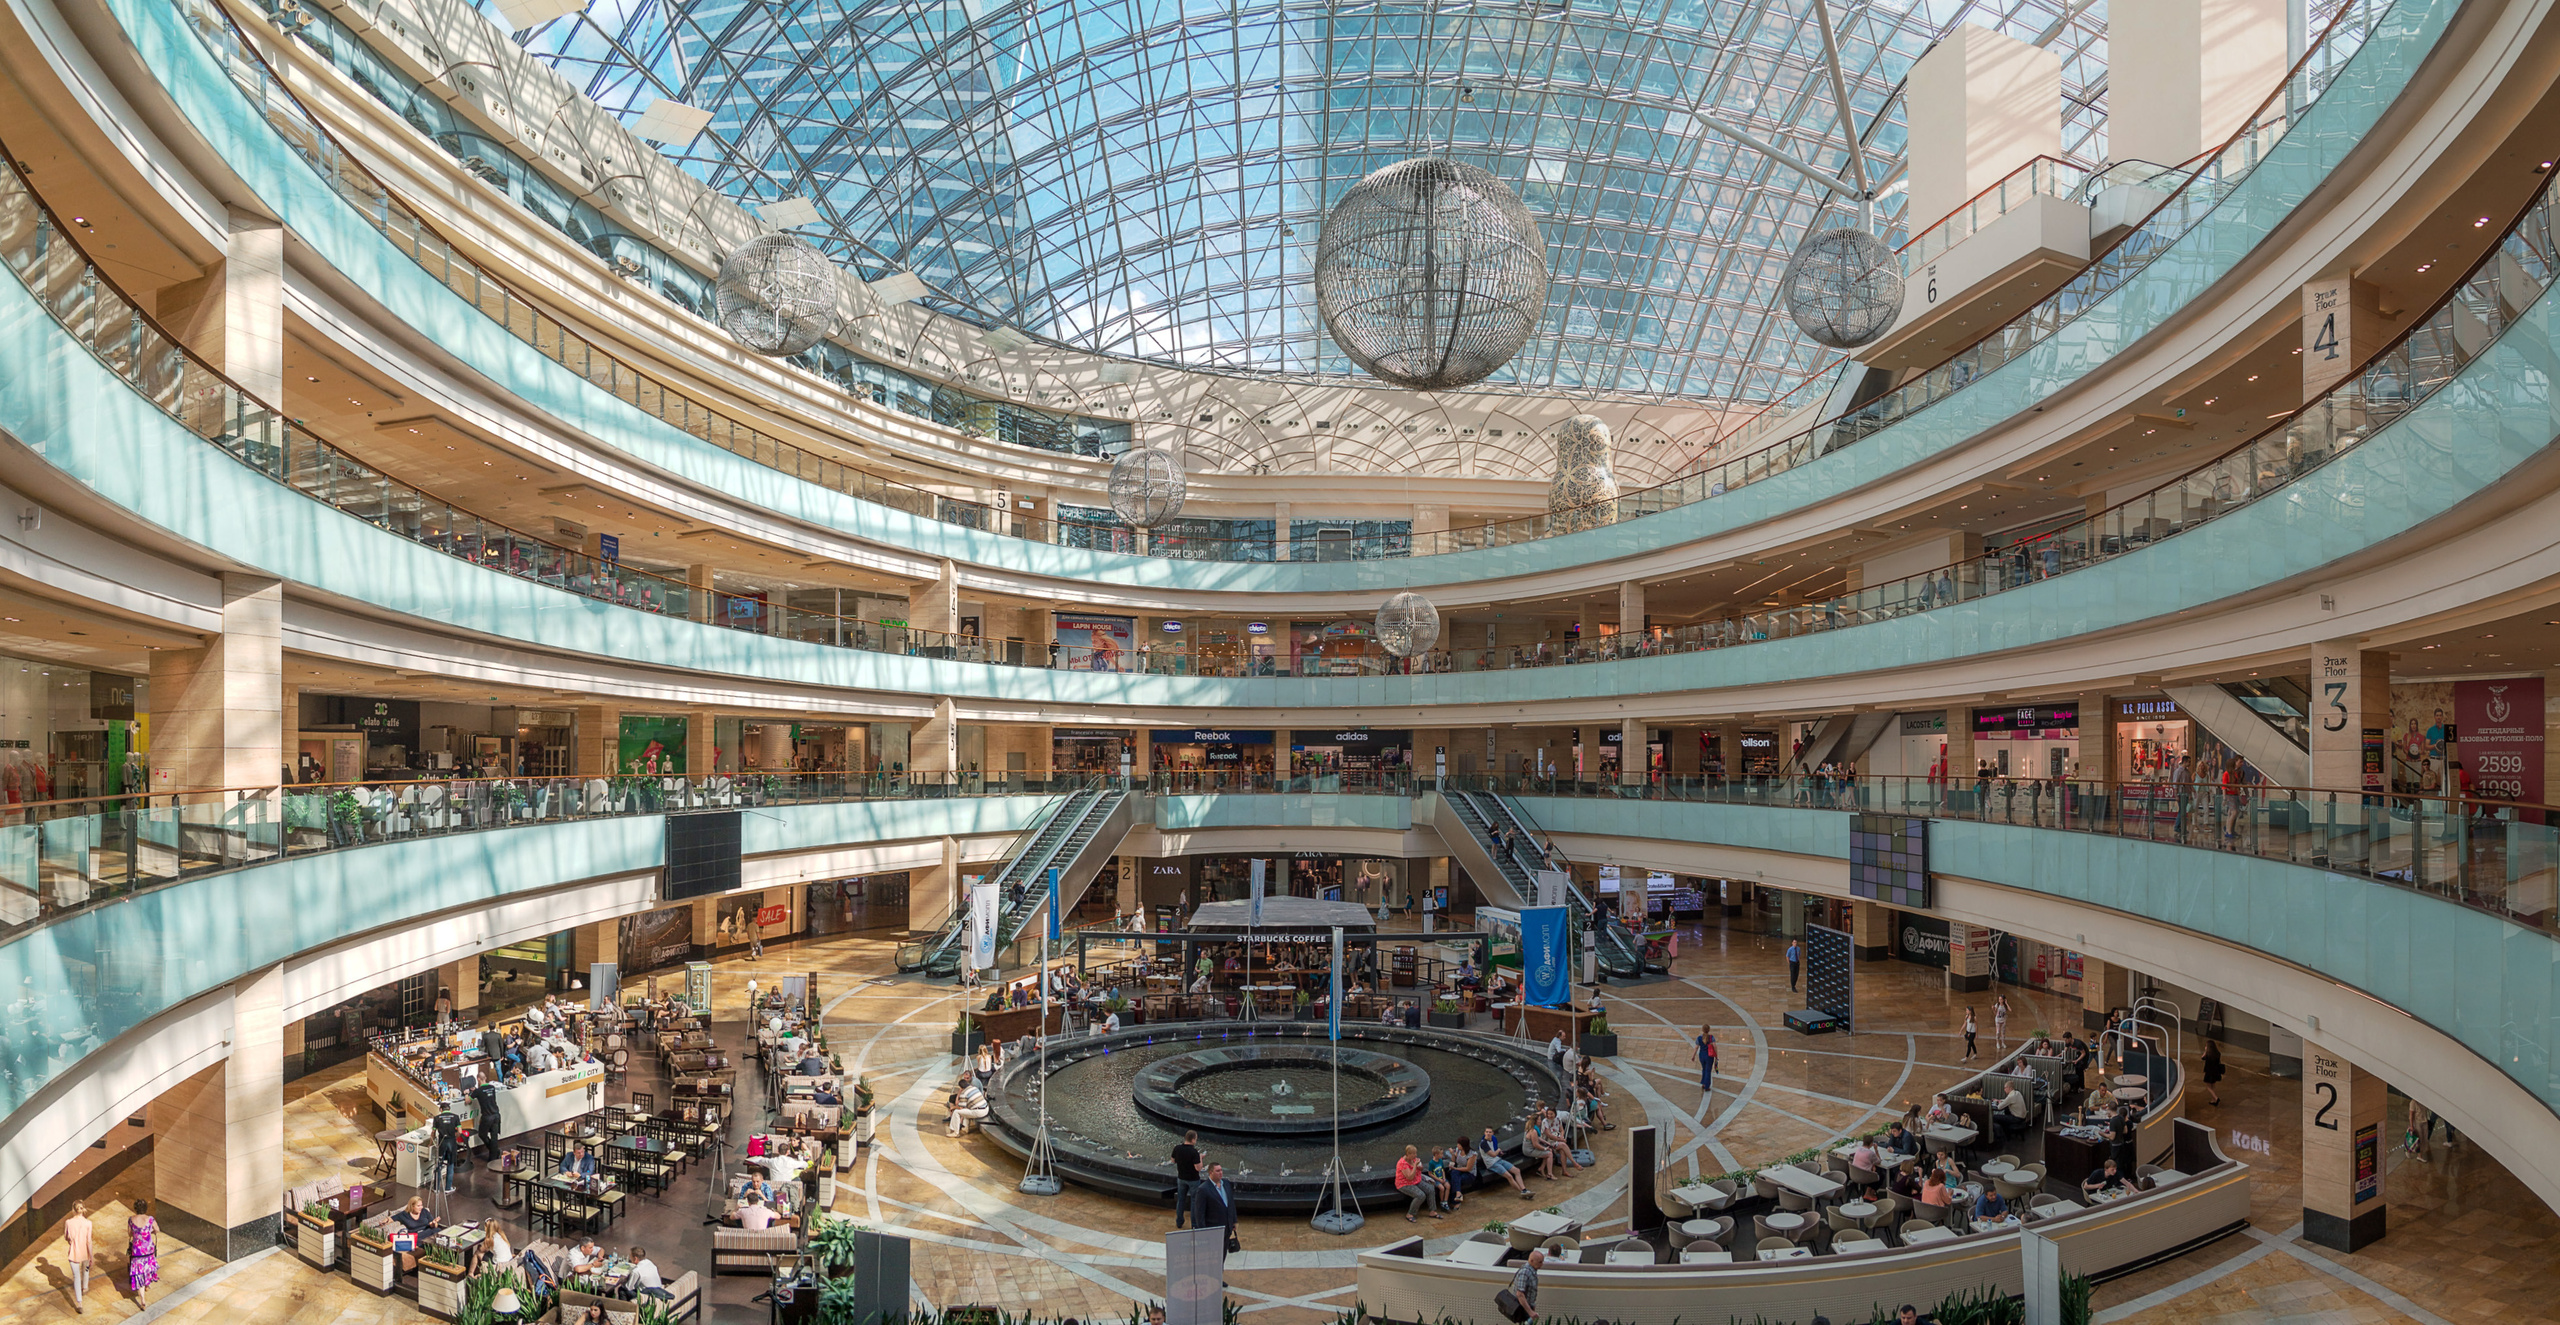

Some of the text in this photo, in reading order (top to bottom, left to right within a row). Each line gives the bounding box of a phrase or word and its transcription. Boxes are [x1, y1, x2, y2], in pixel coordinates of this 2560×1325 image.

[1928, 278, 1937, 303] 6
[2314, 288, 2338, 302] Этаж
[2315, 299, 2337, 312] Floor
[2313, 312, 2340, 361] 4
[997, 492, 1006, 509] 5
[1150, 547, 1207, 560] СОБЕРИ СВОЙ!
[1092, 623, 1112, 631] HOUSE
[1488, 631, 1494, 641] 4
[2323, 656, 2348, 666] Этаж
[2324, 666, 2347, 677] Floor
[2122, 703, 2135, 714] U.S.
[2137, 702, 2154, 714] POLO
[2323, 682, 2348, 732] 3
[2017, 710, 2033, 719] FACE
[1906, 720, 1931, 729] LACOSTE
[1194, 731, 1230, 741] Reebok
[1336, 731, 1369, 741] adidas
[2448, 726, 2454, 741] 3
[1488, 737, 1494, 747] 3
[1437, 746, 1443, 754] 3
[2478, 756, 2522, 773] 2599
[2164, 787, 2174, 798] 50
[2478, 780, 2522, 798] 1999
[1122, 866, 1131, 880] 2
[1153, 866, 1182, 875] ZARA
[1425, 890, 1431, 898] 2
[759, 908, 783, 923] SALE
[1586, 921, 1592, 931] 2
[1237, 935, 1326, 943] STARBUCKS COFFEE
[1542, 924, 1551, 966] АФИМОЛЛ
[1809, 1021, 1835, 1030] AFILOOK
[2314, 1054, 2338, 1069] Этаж
[561, 1068, 599, 1084] SUSHI CITY
[2315, 1065, 2337, 1079] Floor
[2314, 1082, 2338, 1131] 2
